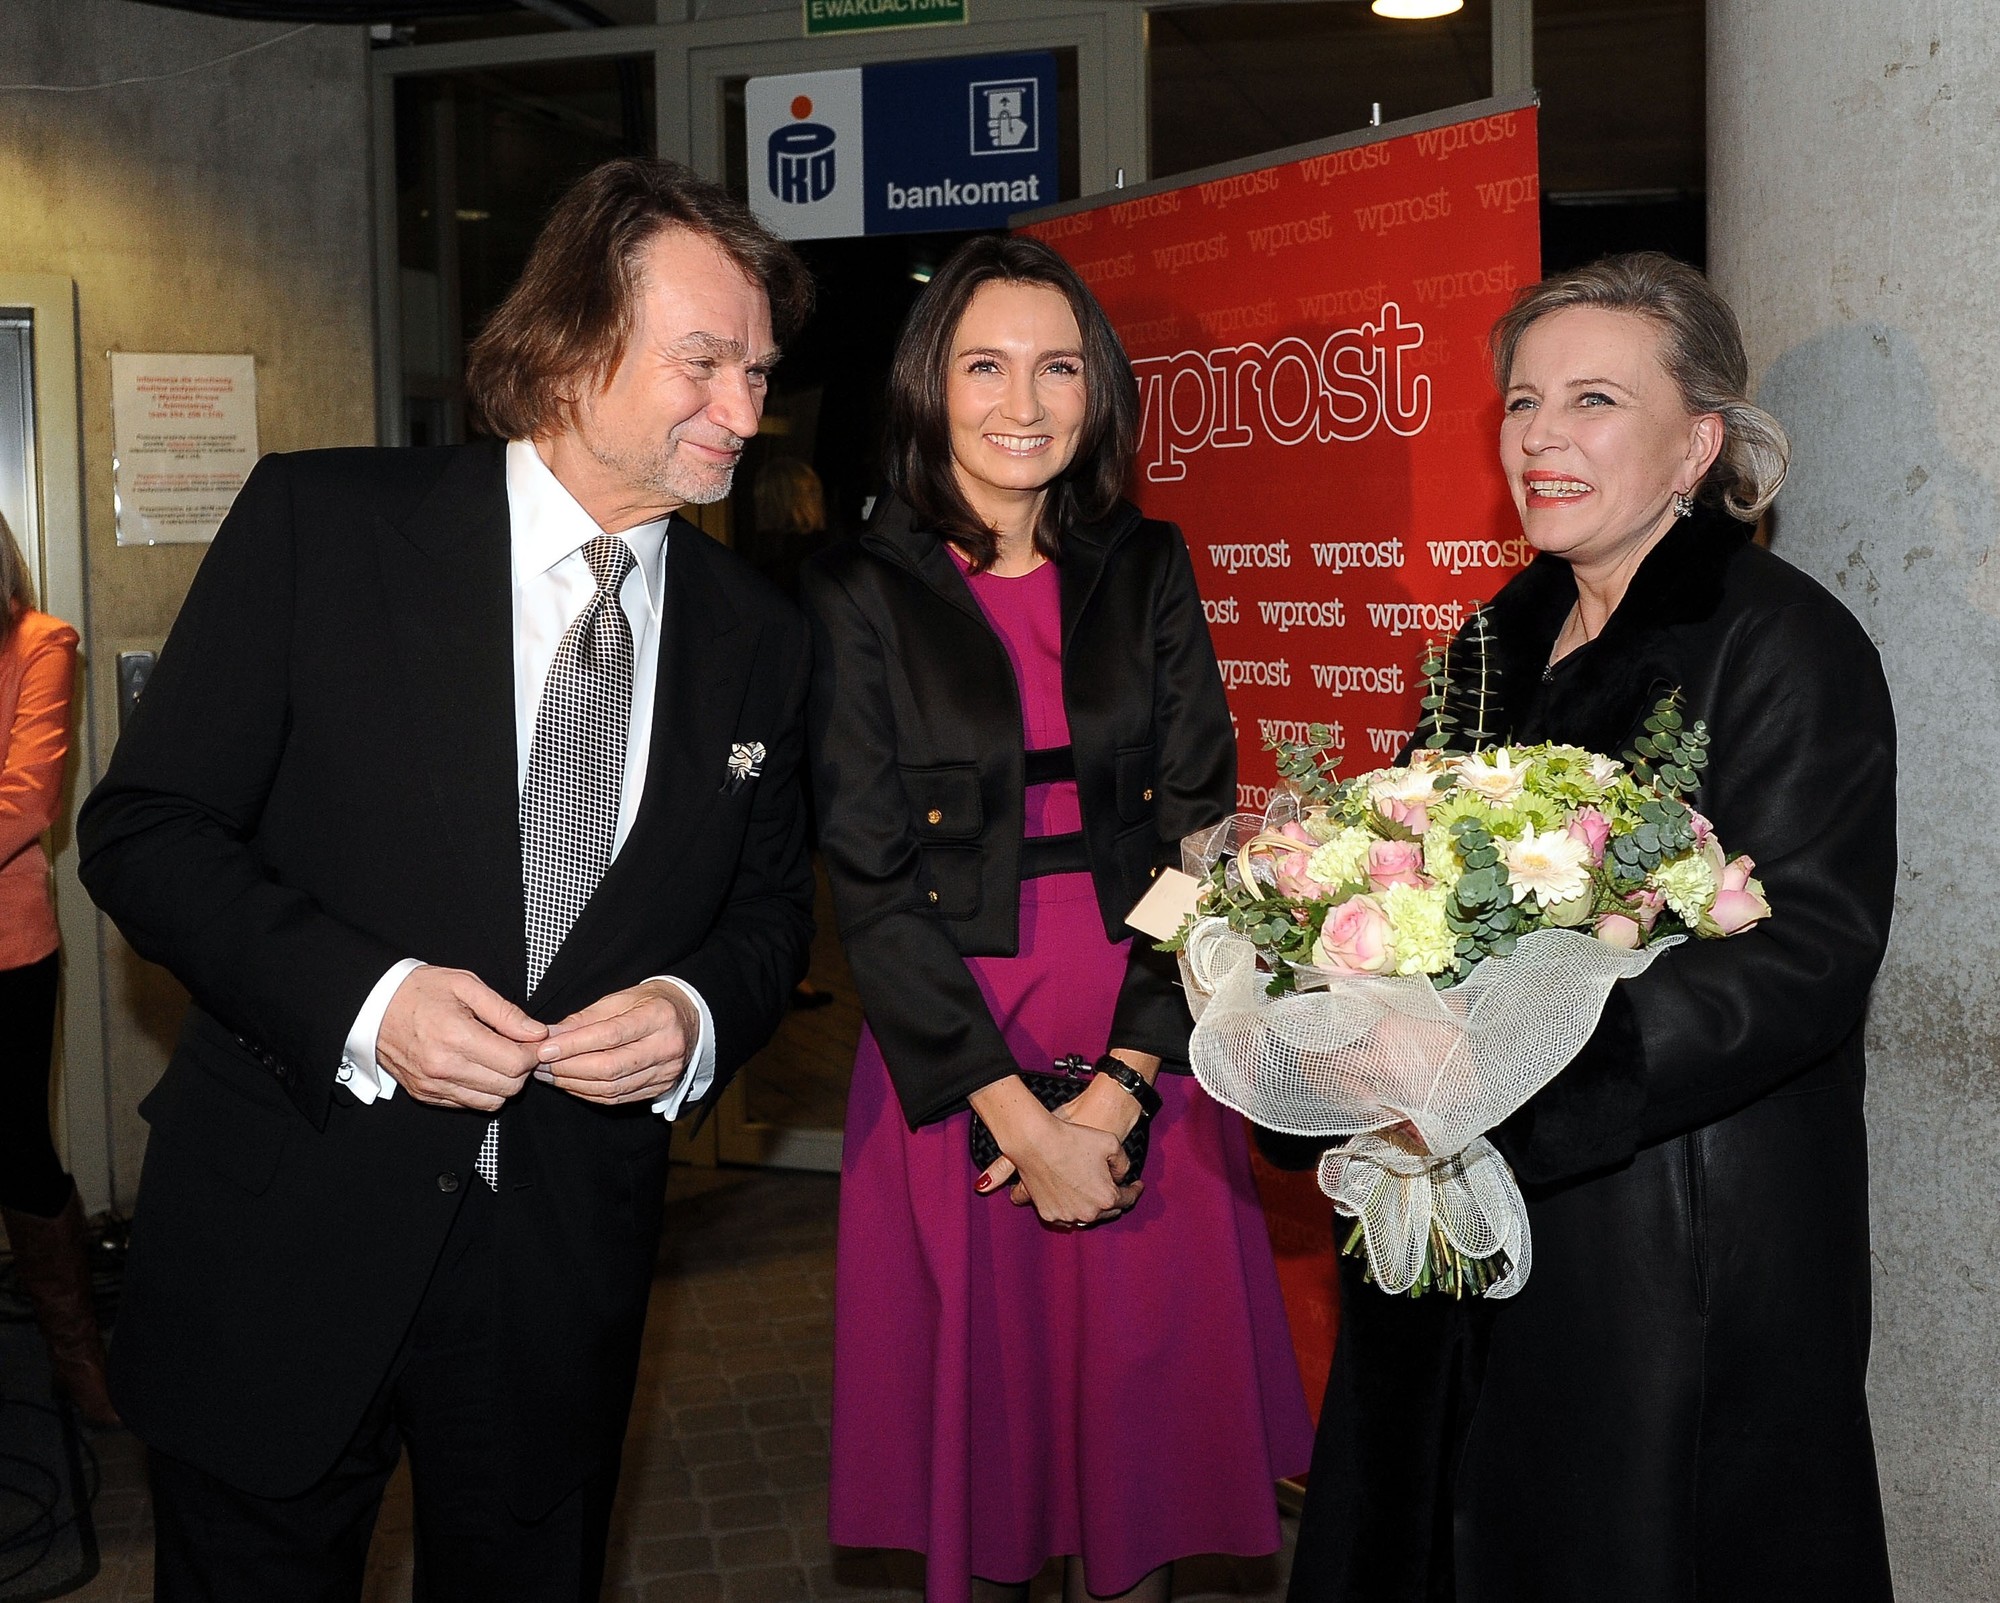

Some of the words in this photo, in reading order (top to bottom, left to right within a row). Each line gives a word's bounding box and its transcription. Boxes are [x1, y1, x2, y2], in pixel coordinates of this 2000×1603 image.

[1107, 193, 1182, 229] wprost
[1199, 167, 1279, 209] wprost
[1300, 141, 1390, 186] wprost
[1413, 112, 1517, 161] wprost
[887, 174, 1040, 210] bankomat
[1075, 251, 1136, 283] prost
[1153, 233, 1229, 274] wprost
[1247, 211, 1333, 257] wprost
[1353, 186, 1451, 236] wprost
[1199, 297, 1279, 339] wprost
[1298, 278, 1389, 322] wprost
[1412, 260, 1518, 310] wprost
[1208, 539, 1291, 574] wprost
[1310, 537, 1405, 575] wprost
[1426, 535, 1534, 575] wprost
[1258, 598, 1345, 632] wprost
[1366, 600, 1465, 636] wprost
[1310, 663, 1404, 697] wprost
[1366, 728, 1414, 762] wp
